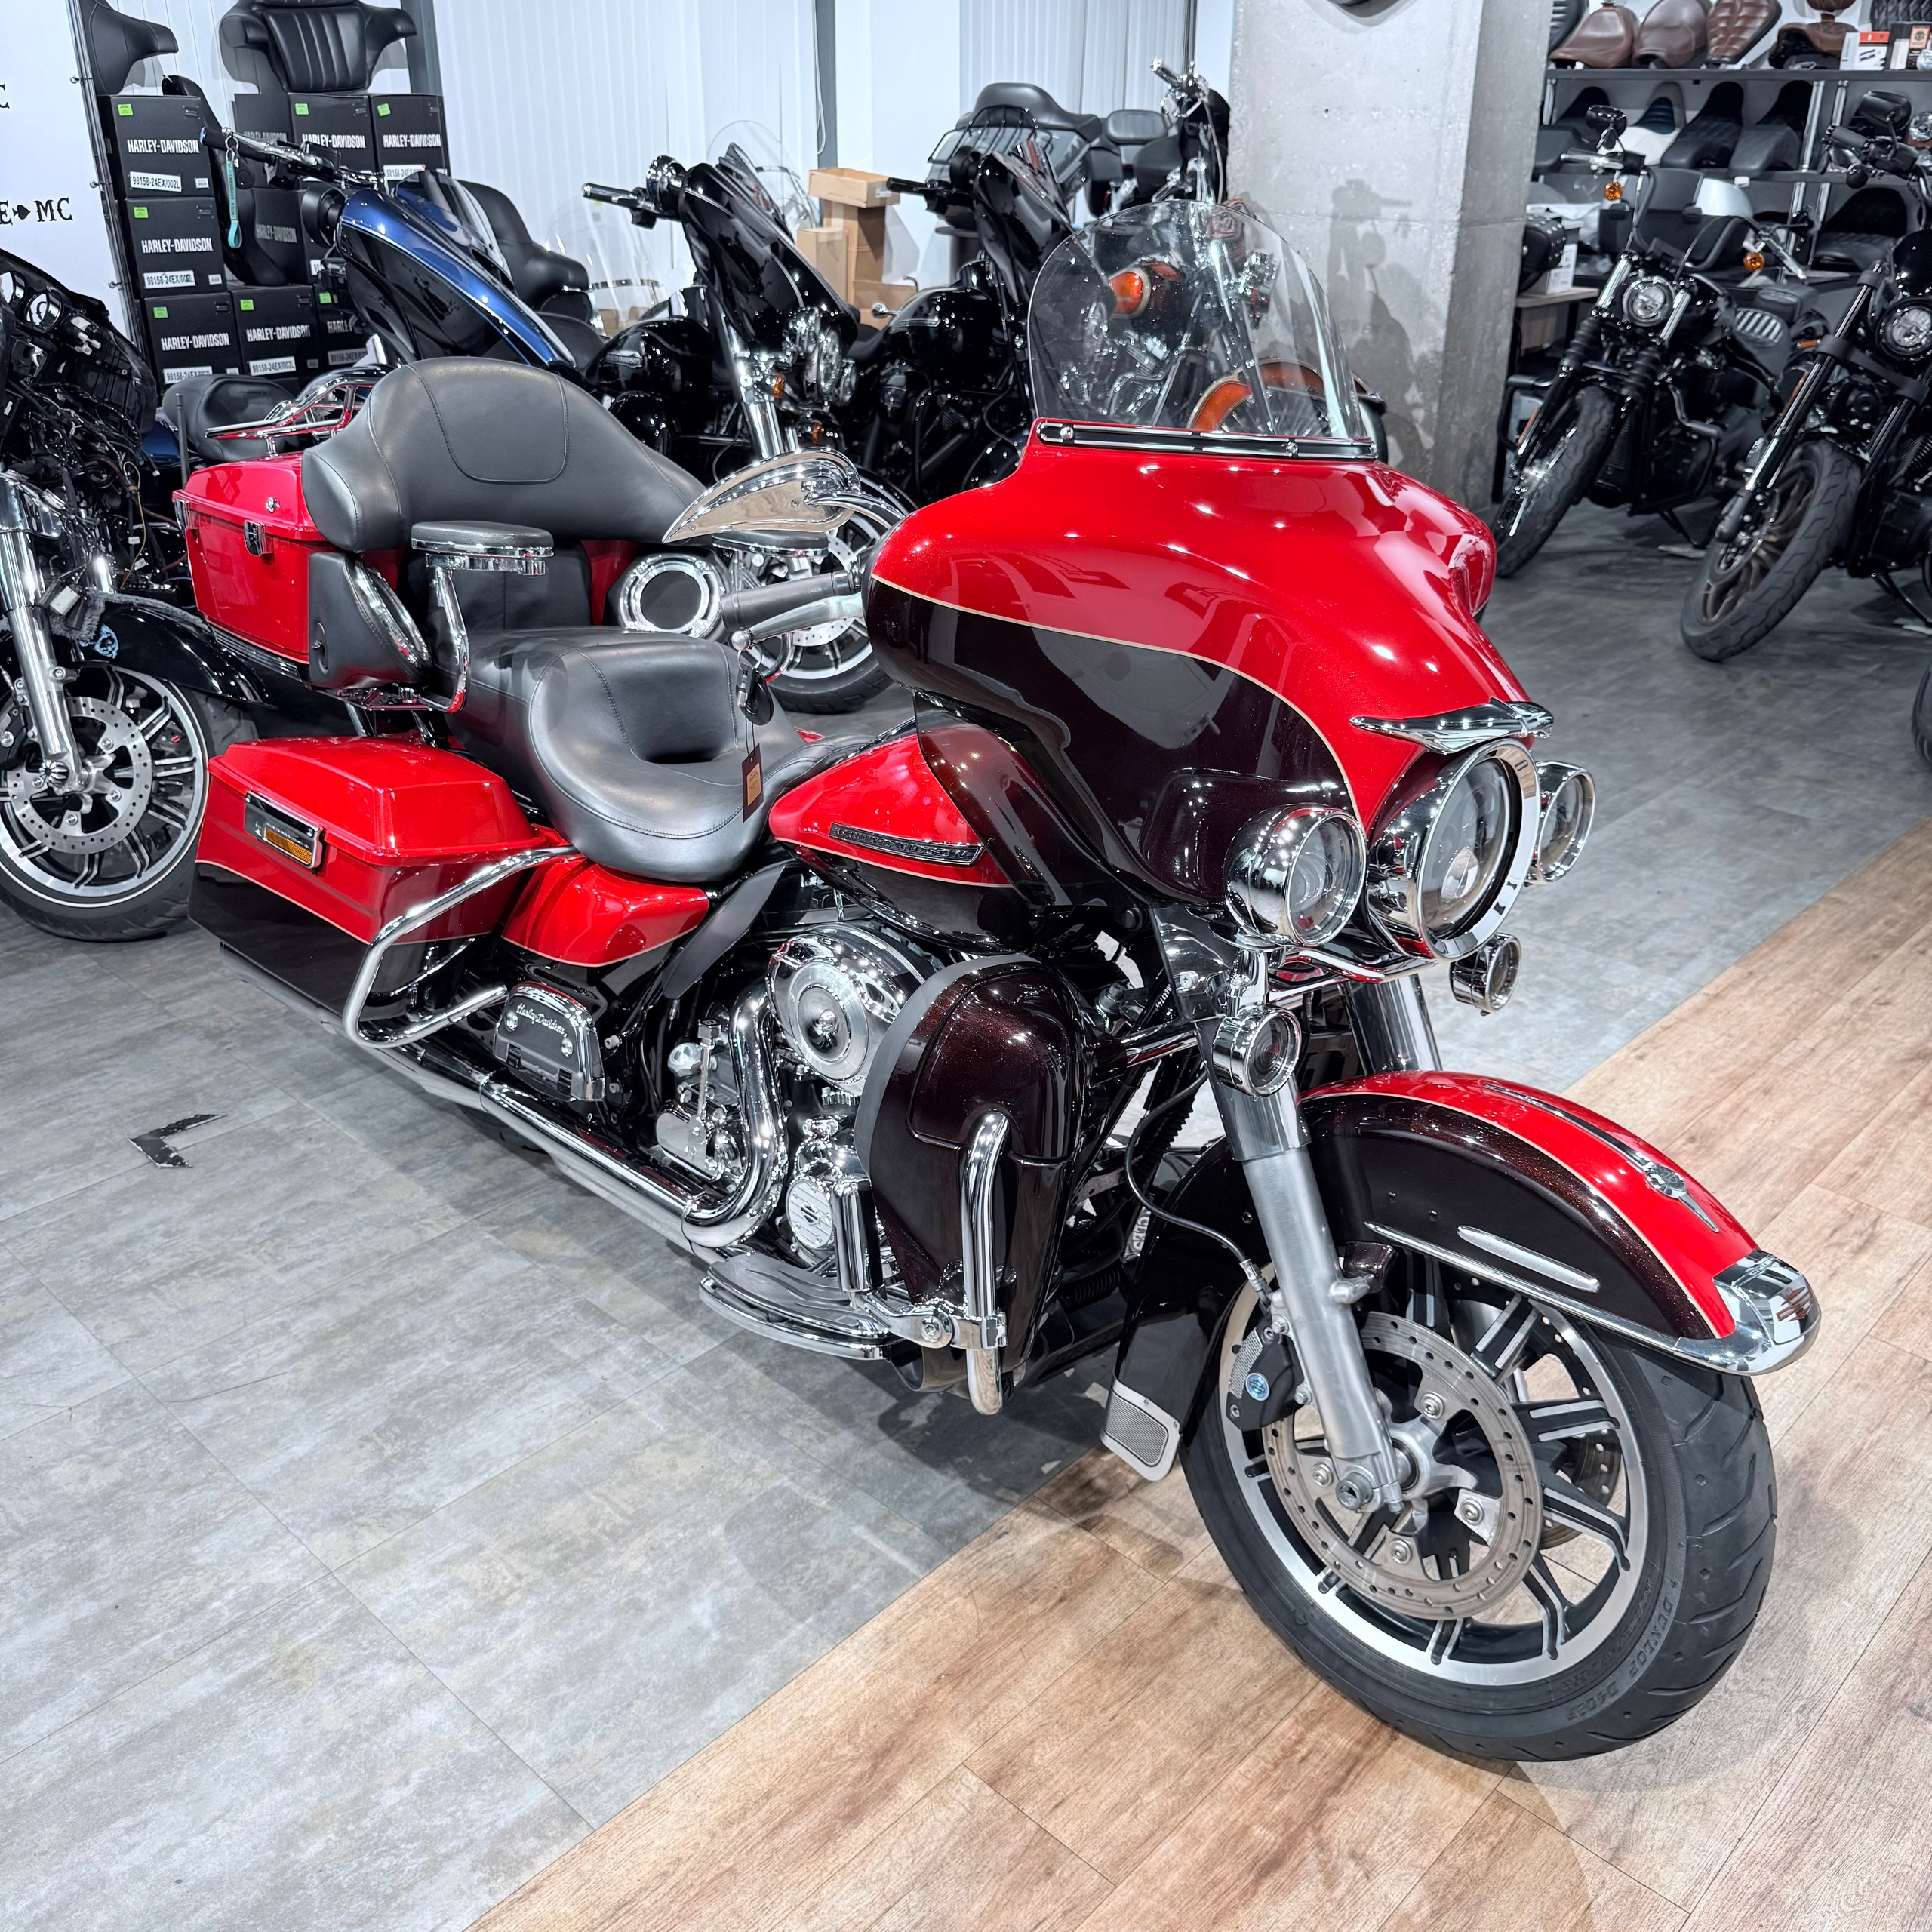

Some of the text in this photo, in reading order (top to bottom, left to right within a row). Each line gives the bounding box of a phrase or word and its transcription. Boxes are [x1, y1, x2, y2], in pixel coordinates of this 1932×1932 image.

[127, 139, 199, 153] HARLEY-DAVIDSON
[383, 134, 441, 148] HARLEY-DAVIDSON
[132, 176, 181, 189] 98158-24EX/002L
[33, 197, 73, 223] MC
[141, 238, 213, 254] HARLEY-DAVIDSON
[161, 333, 230, 351] HARLEY-DAVIDSON
[246, 325, 311, 342] HARLEY-DAVIDSON
[516, 1002, 566, 1037] Harley-Davidson
[1629, 1596, 1674, 1680] DUNLOP
